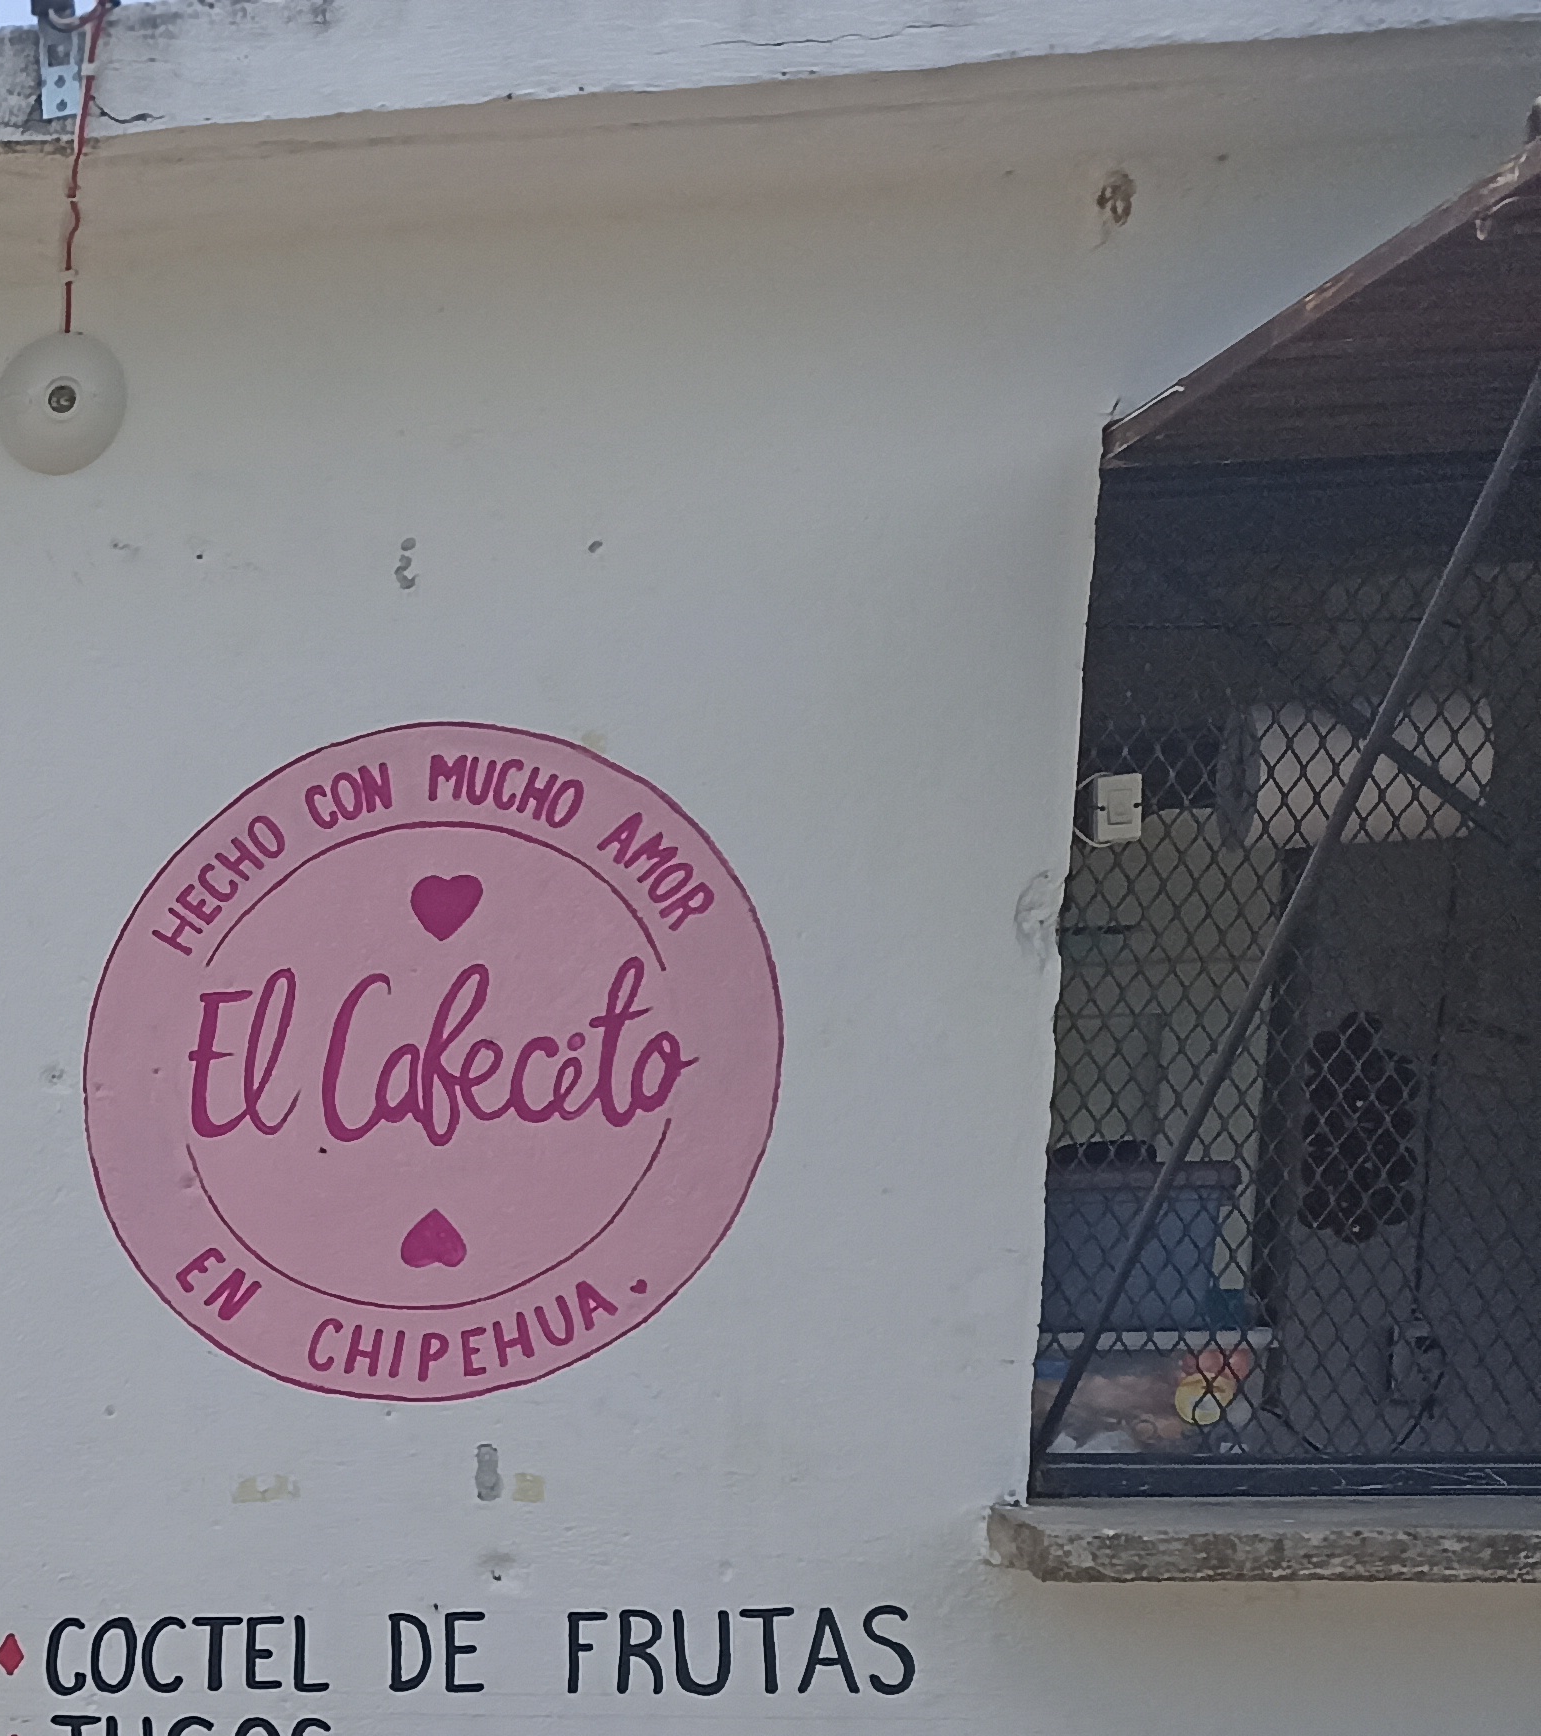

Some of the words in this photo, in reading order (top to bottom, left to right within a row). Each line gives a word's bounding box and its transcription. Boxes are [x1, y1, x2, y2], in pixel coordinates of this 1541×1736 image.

[151, 814, 286, 956] HECHO
[303, 762, 393, 829] CON
[427, 754, 585, 828] MUCHO
[597, 812, 715, 931] AMOR
[187, 967, 301, 1139] El
[321, 956, 699, 1146] Cafecito
[175, 1246, 263, 1321] EN
[44, 1615, 330, 1697] COCTEL
[388, 1611, 486, 1695] DE
[566, 1605, 918, 1697] FRUTAS
